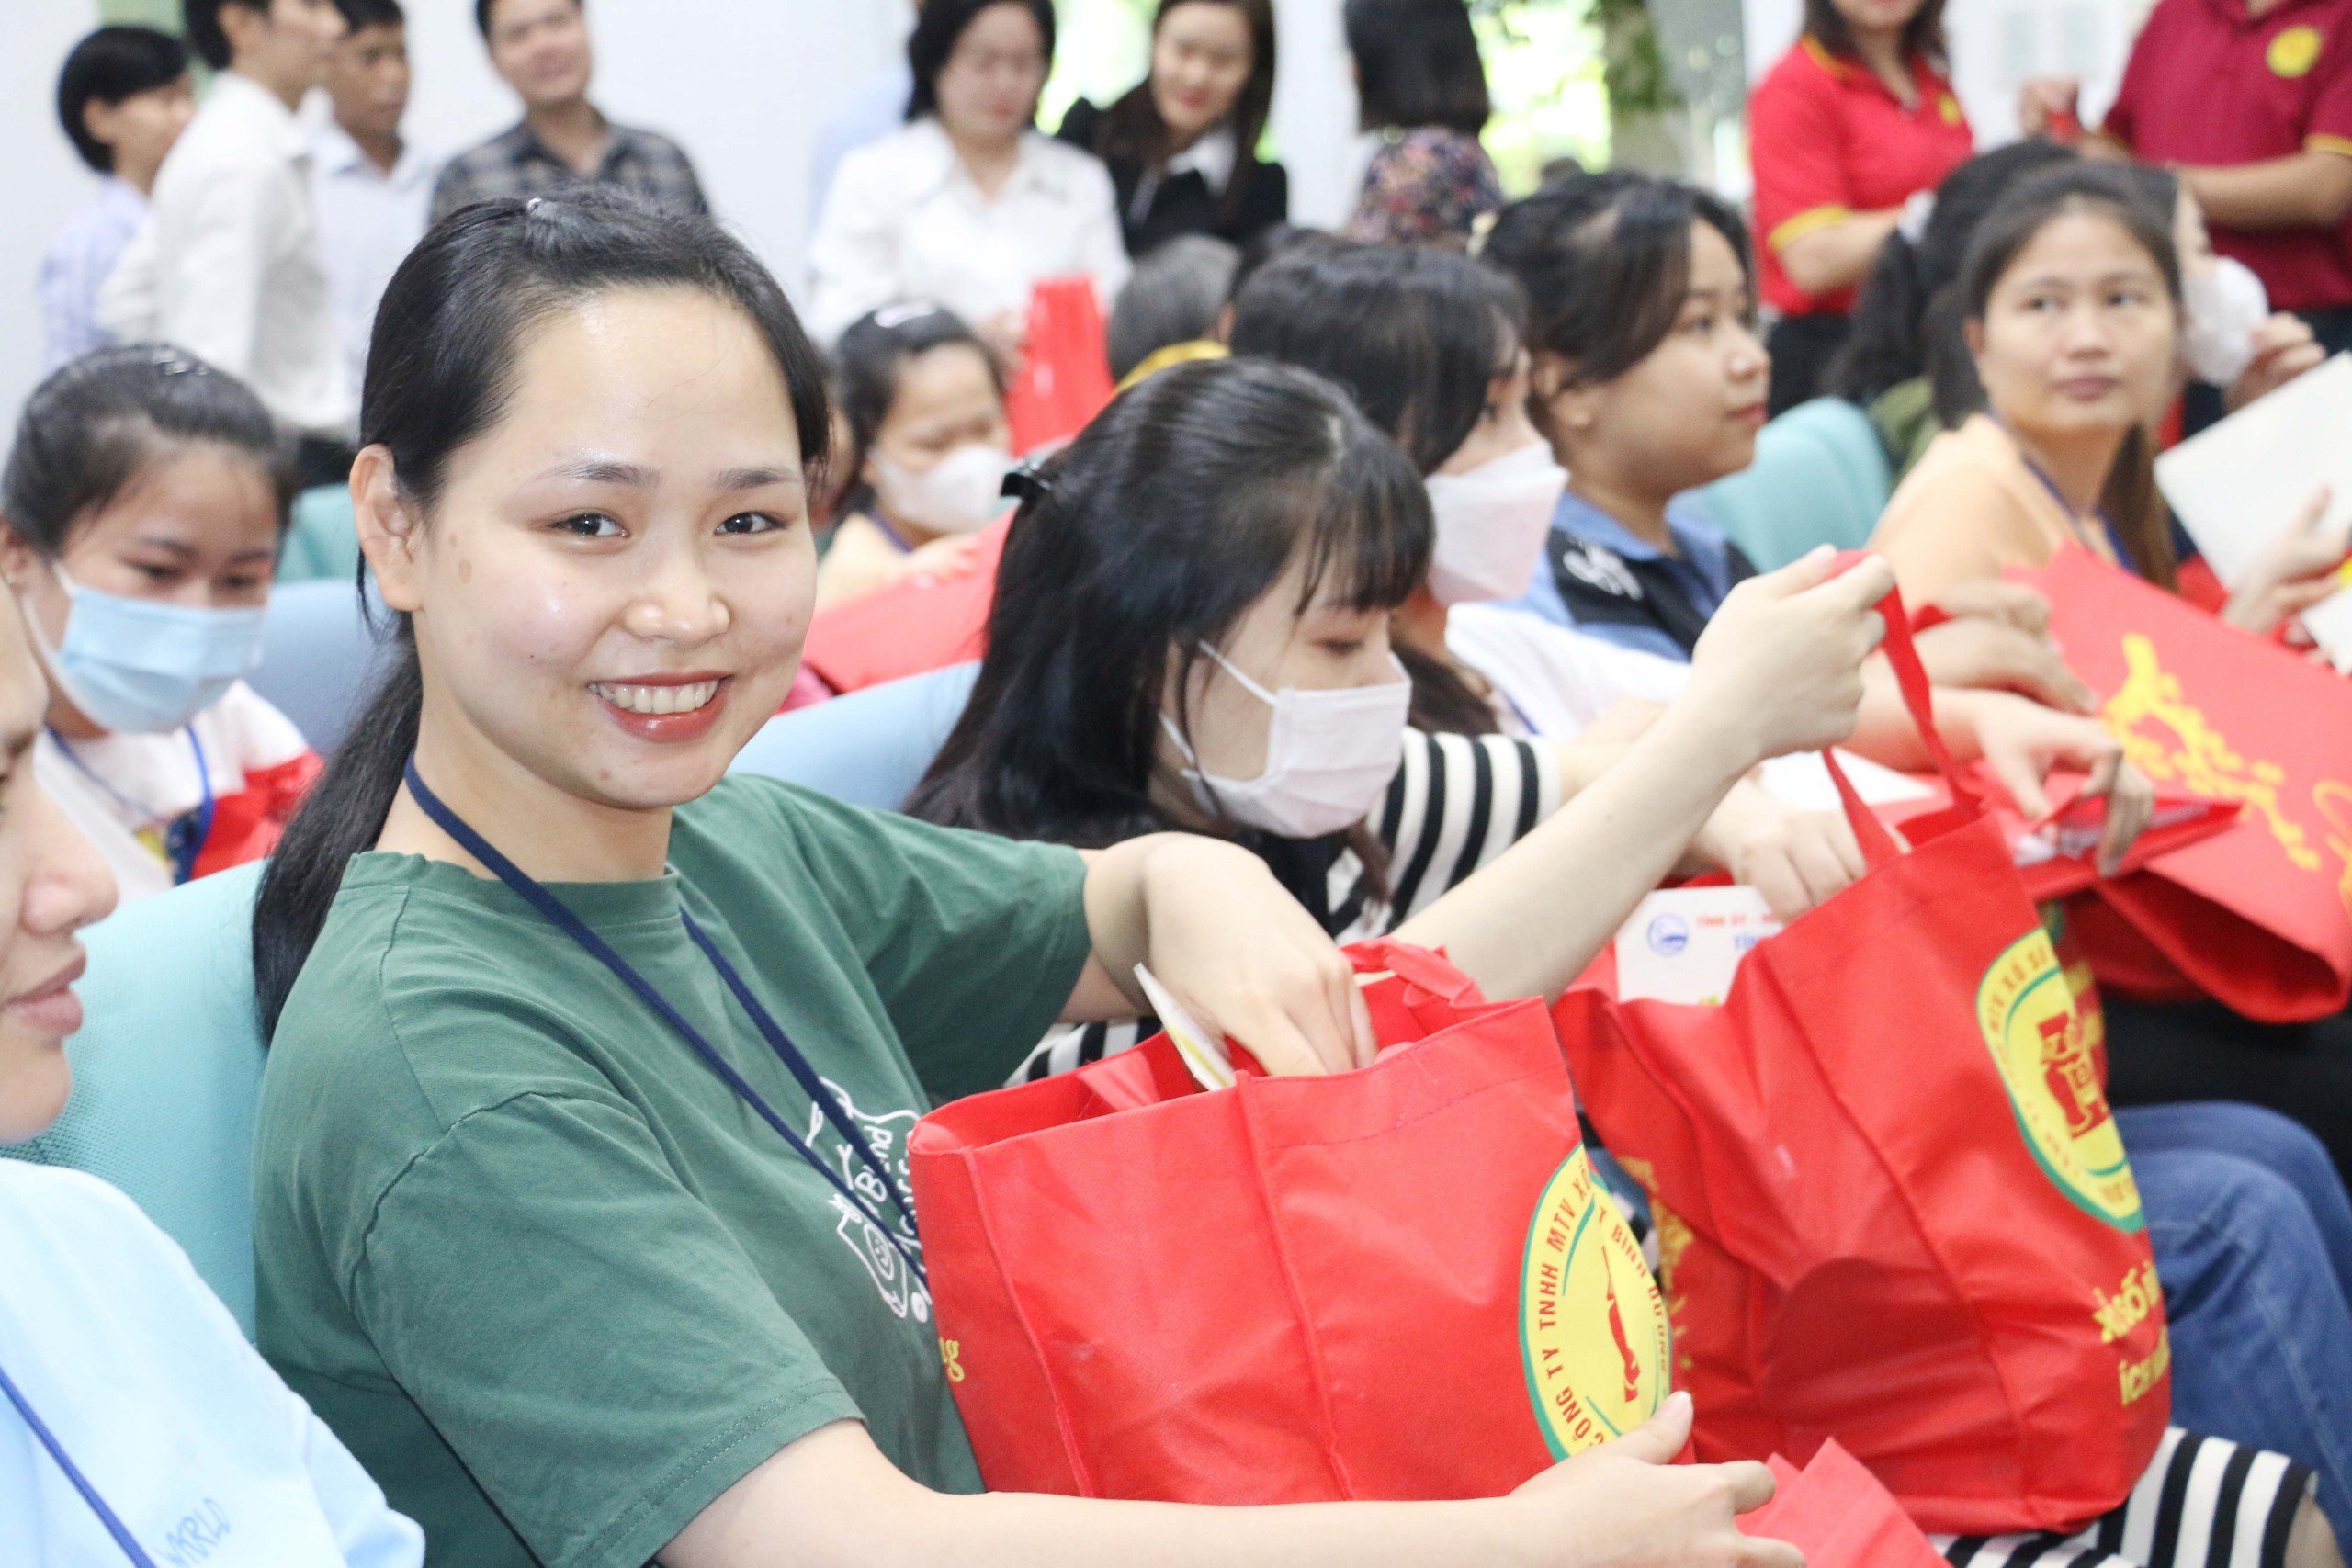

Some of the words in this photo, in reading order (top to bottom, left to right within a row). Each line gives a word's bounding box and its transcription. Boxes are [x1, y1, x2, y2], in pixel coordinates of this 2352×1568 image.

[1546, 1197, 1576, 1253] MTV
[1539, 1262, 1560, 1330] TNHH
[1542, 1347, 1564, 1380] TY
